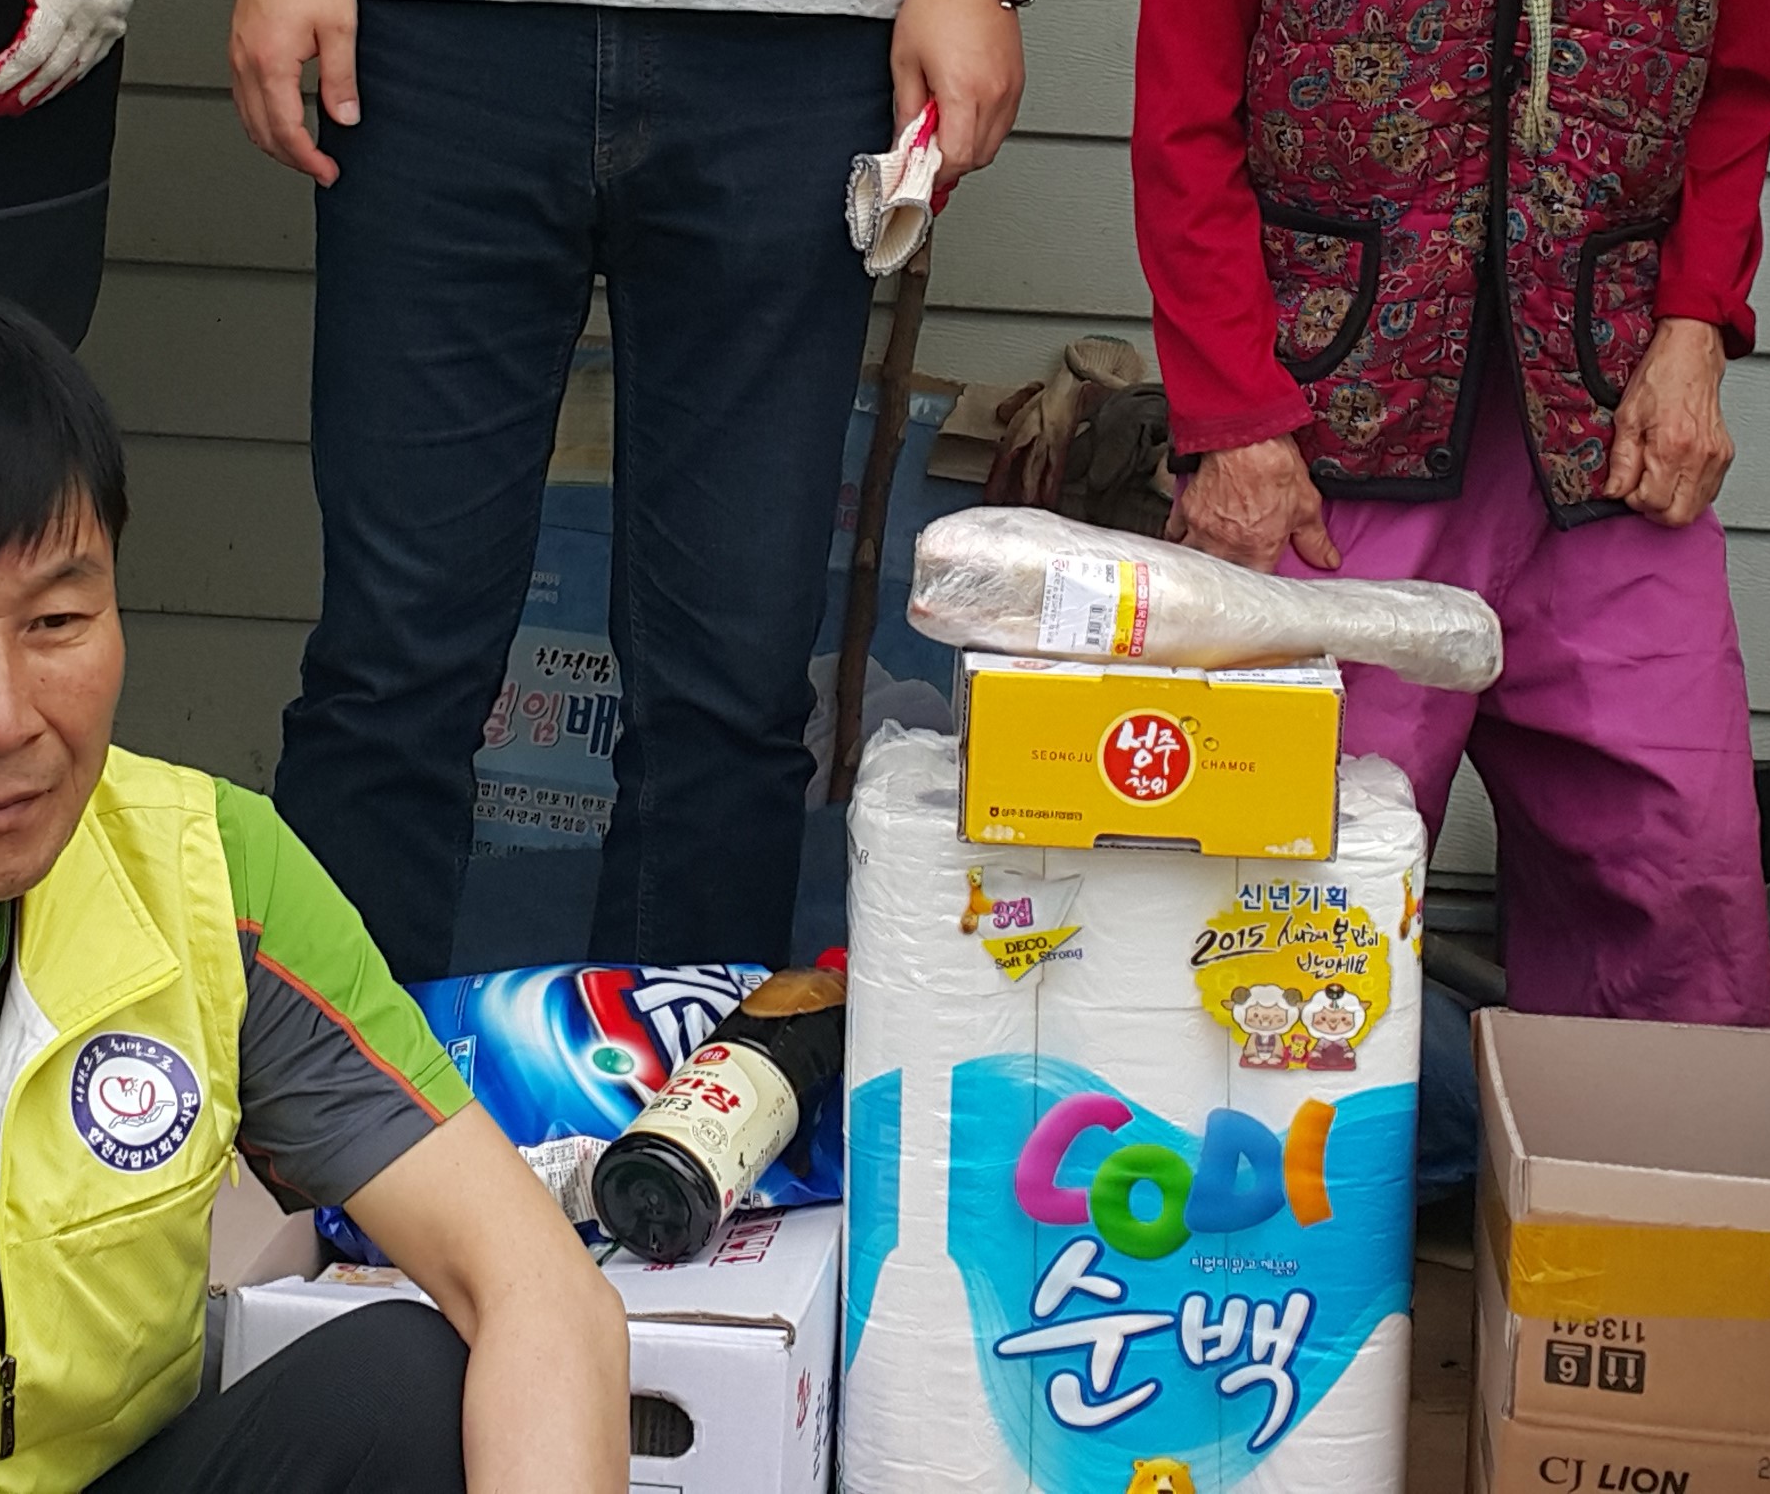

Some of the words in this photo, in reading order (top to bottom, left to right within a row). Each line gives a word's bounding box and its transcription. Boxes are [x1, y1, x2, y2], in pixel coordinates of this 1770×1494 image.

[535, 647, 612, 684] 친정맘
[1031, 749, 1093, 764] SEONGJU
[1116, 719, 1180, 775] 성주
[1201, 759, 1257, 774] CHAMOE
[1125, 769, 1168, 796] 참외
[503, 808, 541, 825] 사랑과
[549, 814, 586, 833] 정성을
[1238, 883, 1348, 912] 신년기획
[1004, 936, 1053, 954] DECO.
[1190, 923, 1267, 966] 2015
[1277, 915, 1328, 947] 새해
[1331, 917, 1352, 953] 복
[1353, 924, 1379, 948] 많이
[995, 955, 1023, 970] Soft
[1025, 953, 1036, 966] &
[1038, 947, 1084, 966] Strong
[1296, 951, 1369, 980] 받으세요
[661, 1078, 742, 1114] 간장
[1015, 1092, 1337, 1260] CODI
[996, 1238, 1313, 1452] 순백
[1539, 1456, 1587, 1490] CJ
[1597, 1463, 1690, 1494] LION
